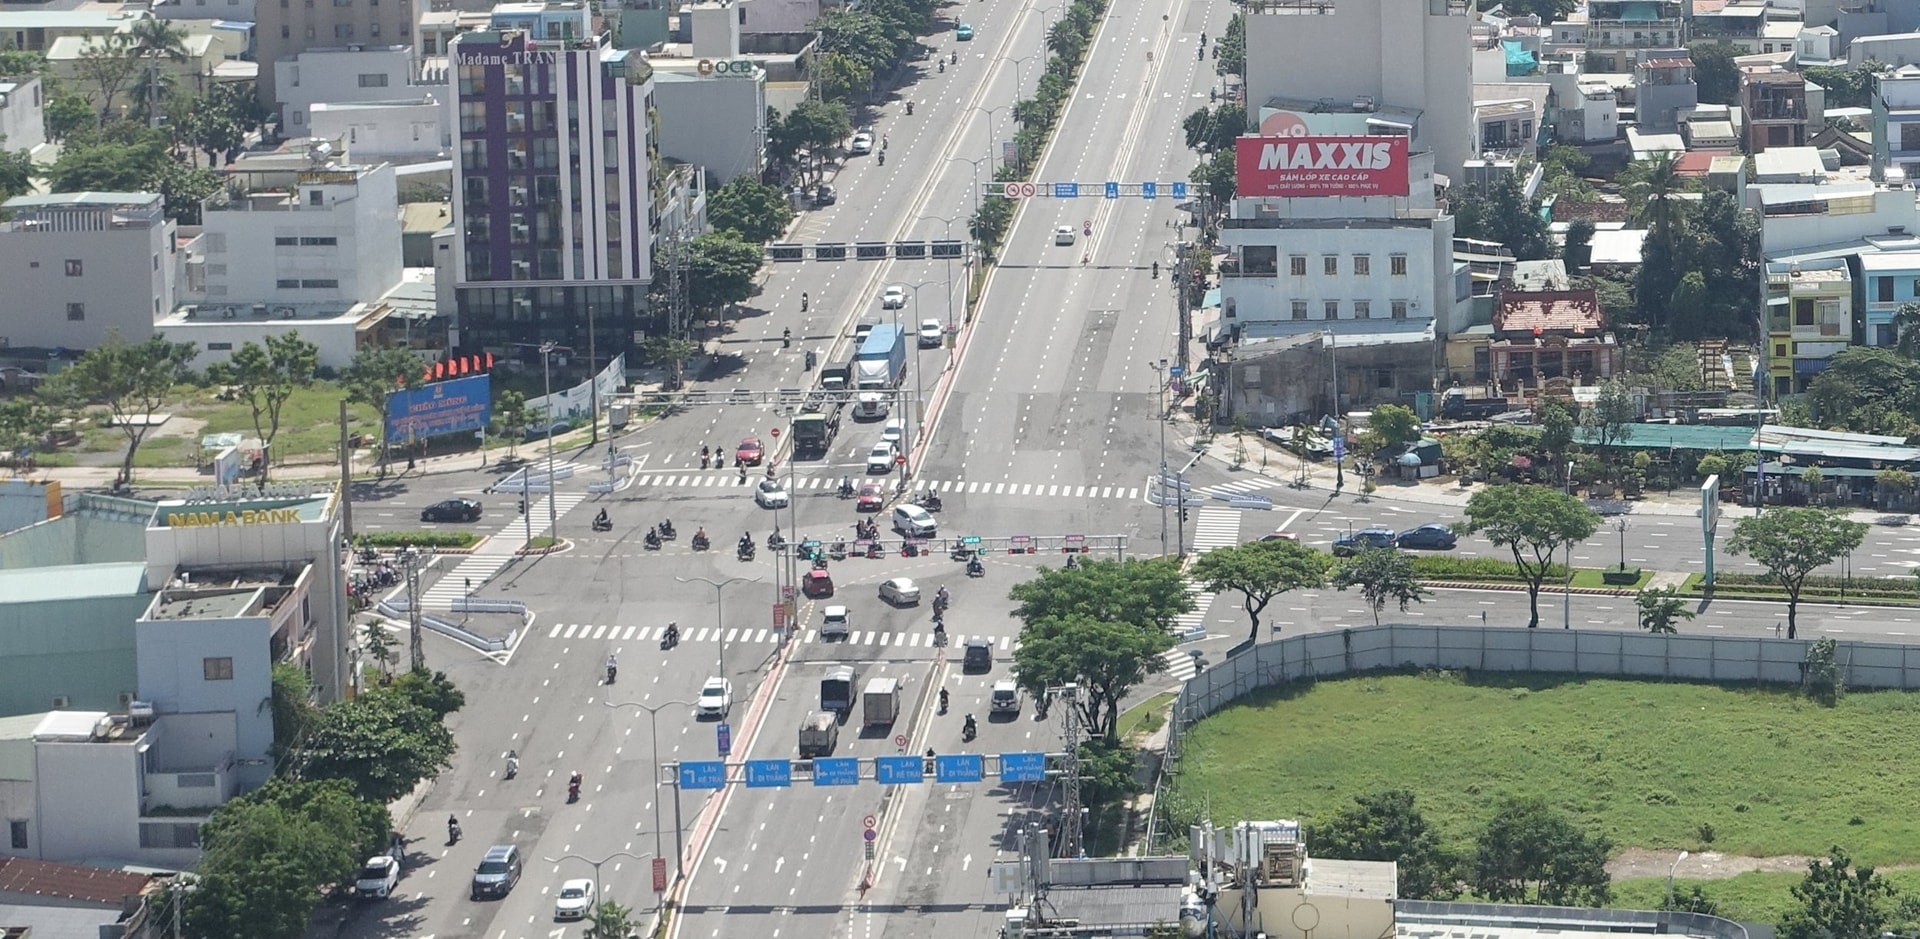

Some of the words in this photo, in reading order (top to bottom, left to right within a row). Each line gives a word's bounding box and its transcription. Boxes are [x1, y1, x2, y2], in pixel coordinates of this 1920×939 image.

[455, 52, 508, 65] Madame
[512, 51, 556, 64] TRAN
[716, 60, 751, 78] OCB
[1258, 142, 1392, 170] MAXXIS
[1332, 173, 1350, 181] CAO
[168, 511, 219, 528] NAM
[223, 510, 238, 525] A
[241, 508, 301, 525] BANK
